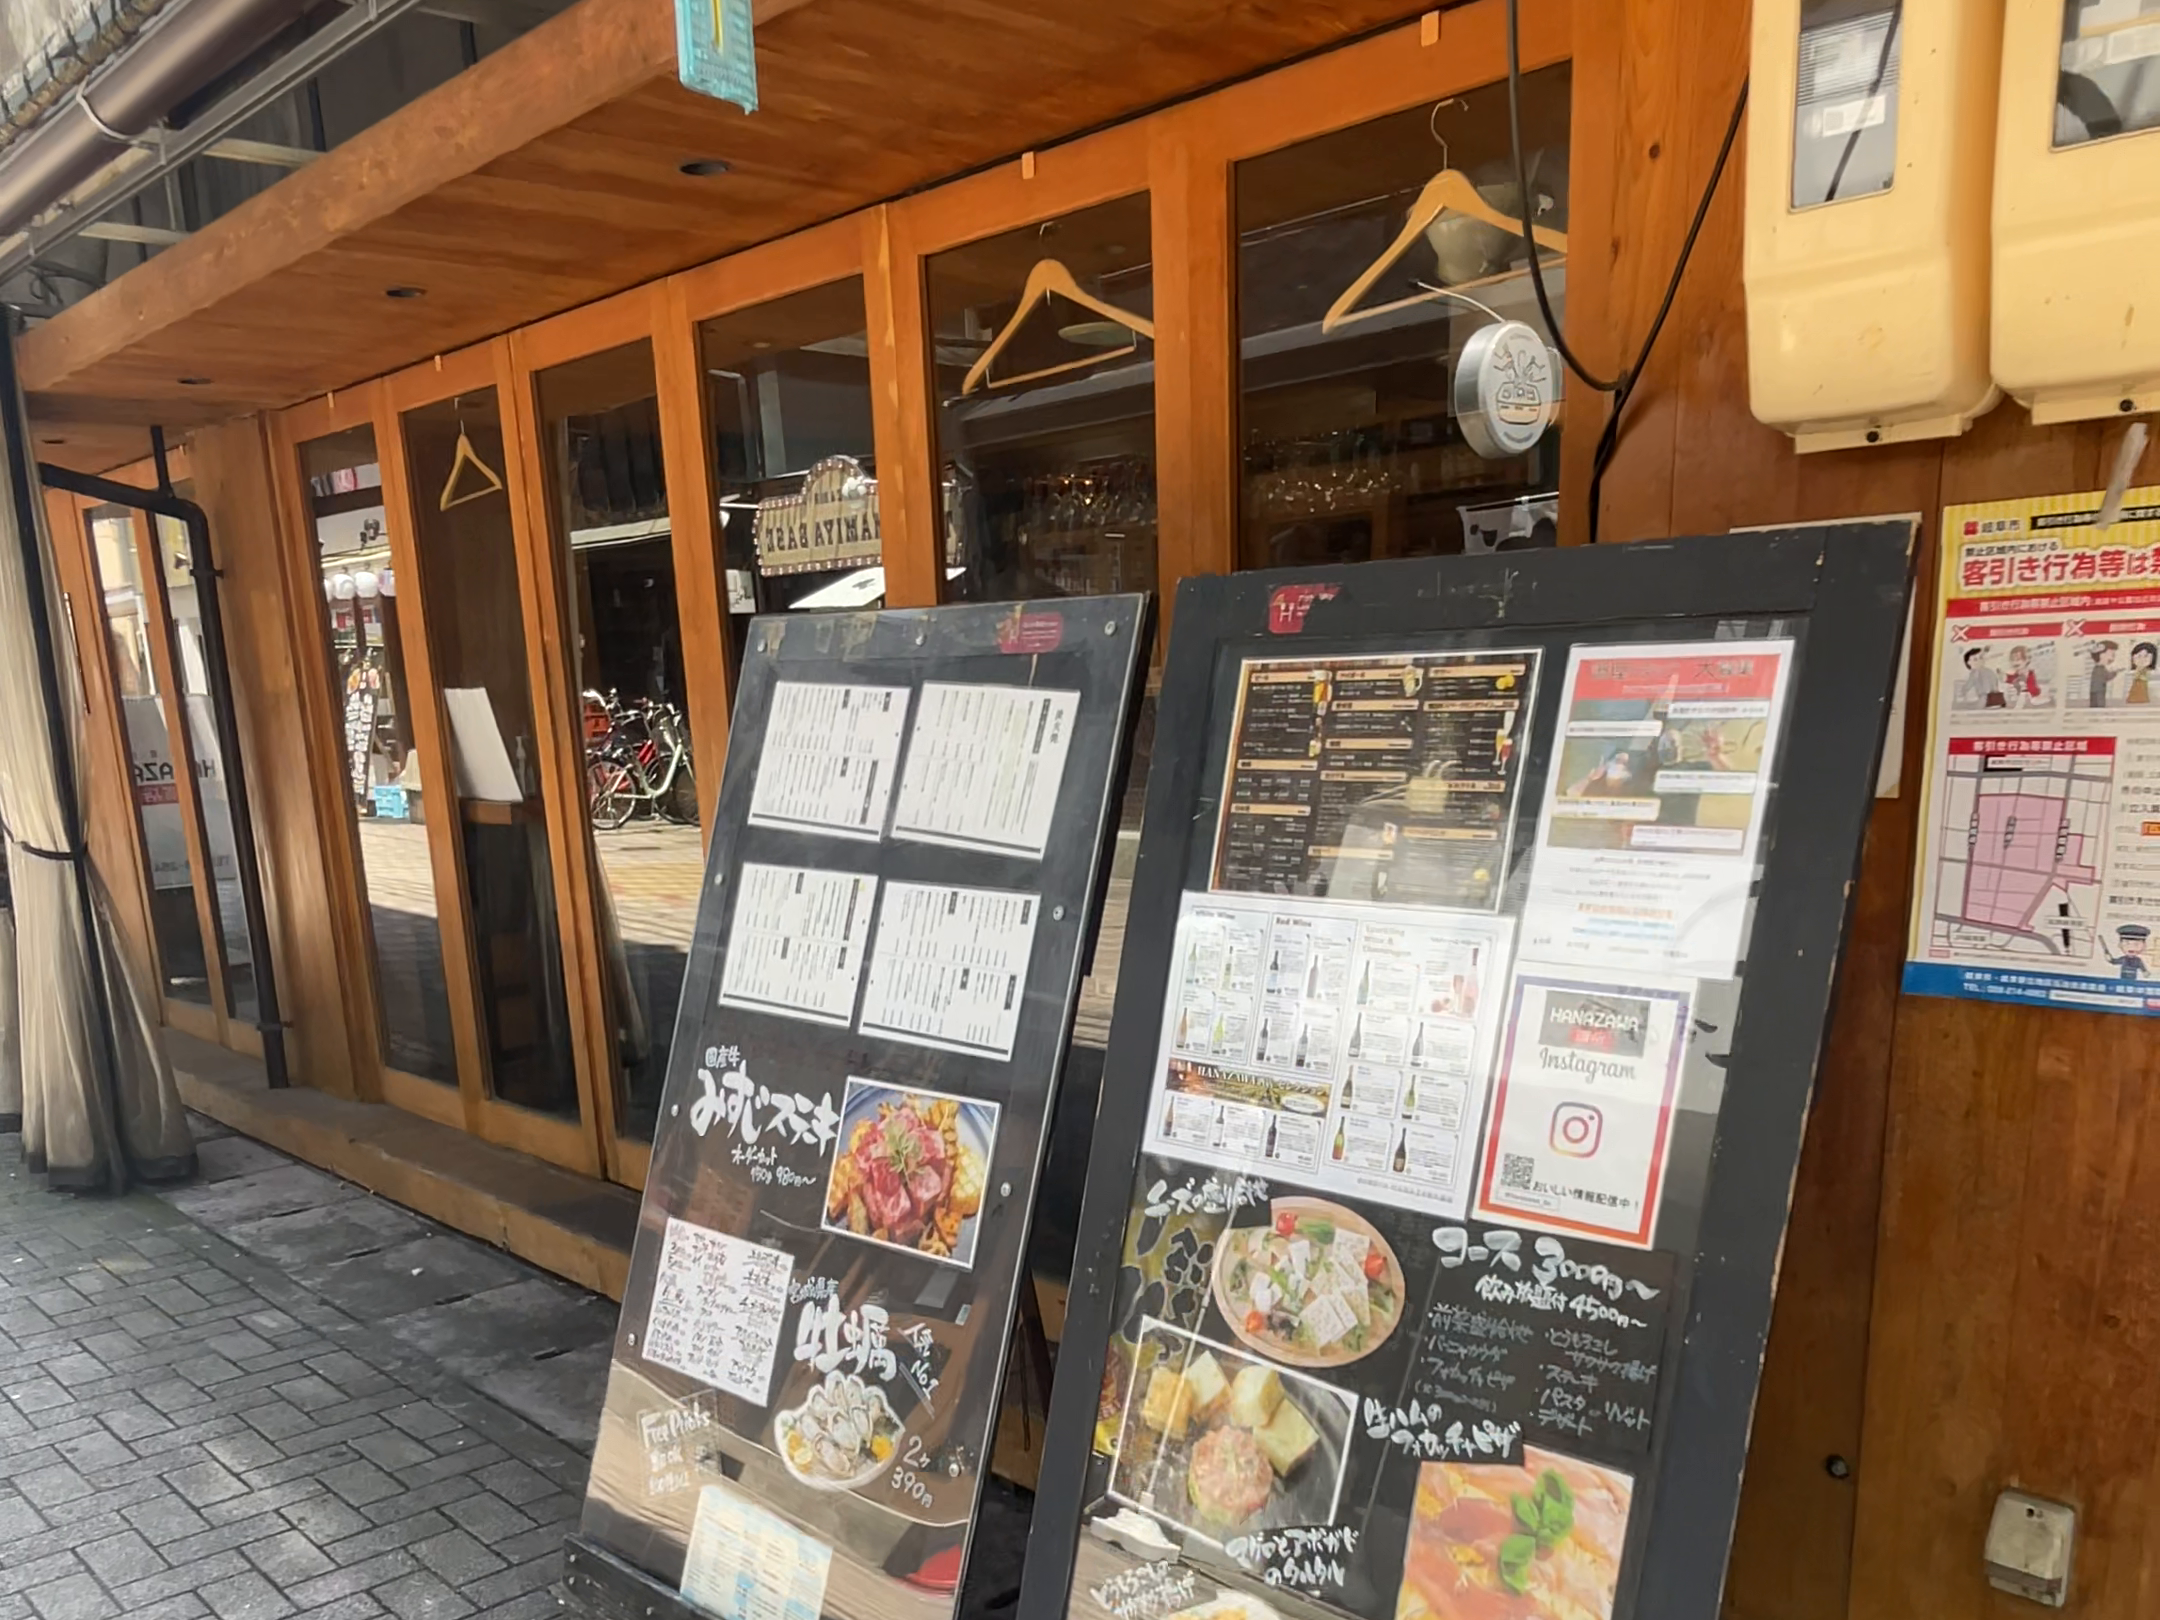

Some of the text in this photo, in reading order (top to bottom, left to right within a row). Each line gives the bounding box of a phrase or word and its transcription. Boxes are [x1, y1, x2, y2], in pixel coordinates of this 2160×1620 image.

[1550, 1007, 1639, 1033] HANAZAWA
[705, 1044, 741, 1069] 国産牛
[1539, 1047, 1636, 1085] Instagram
[1433, 1226, 1521, 1272] コース
[1363, 1397, 1443, 1441] 生ハムの
[891, 1466, 934, 1509] 390円
